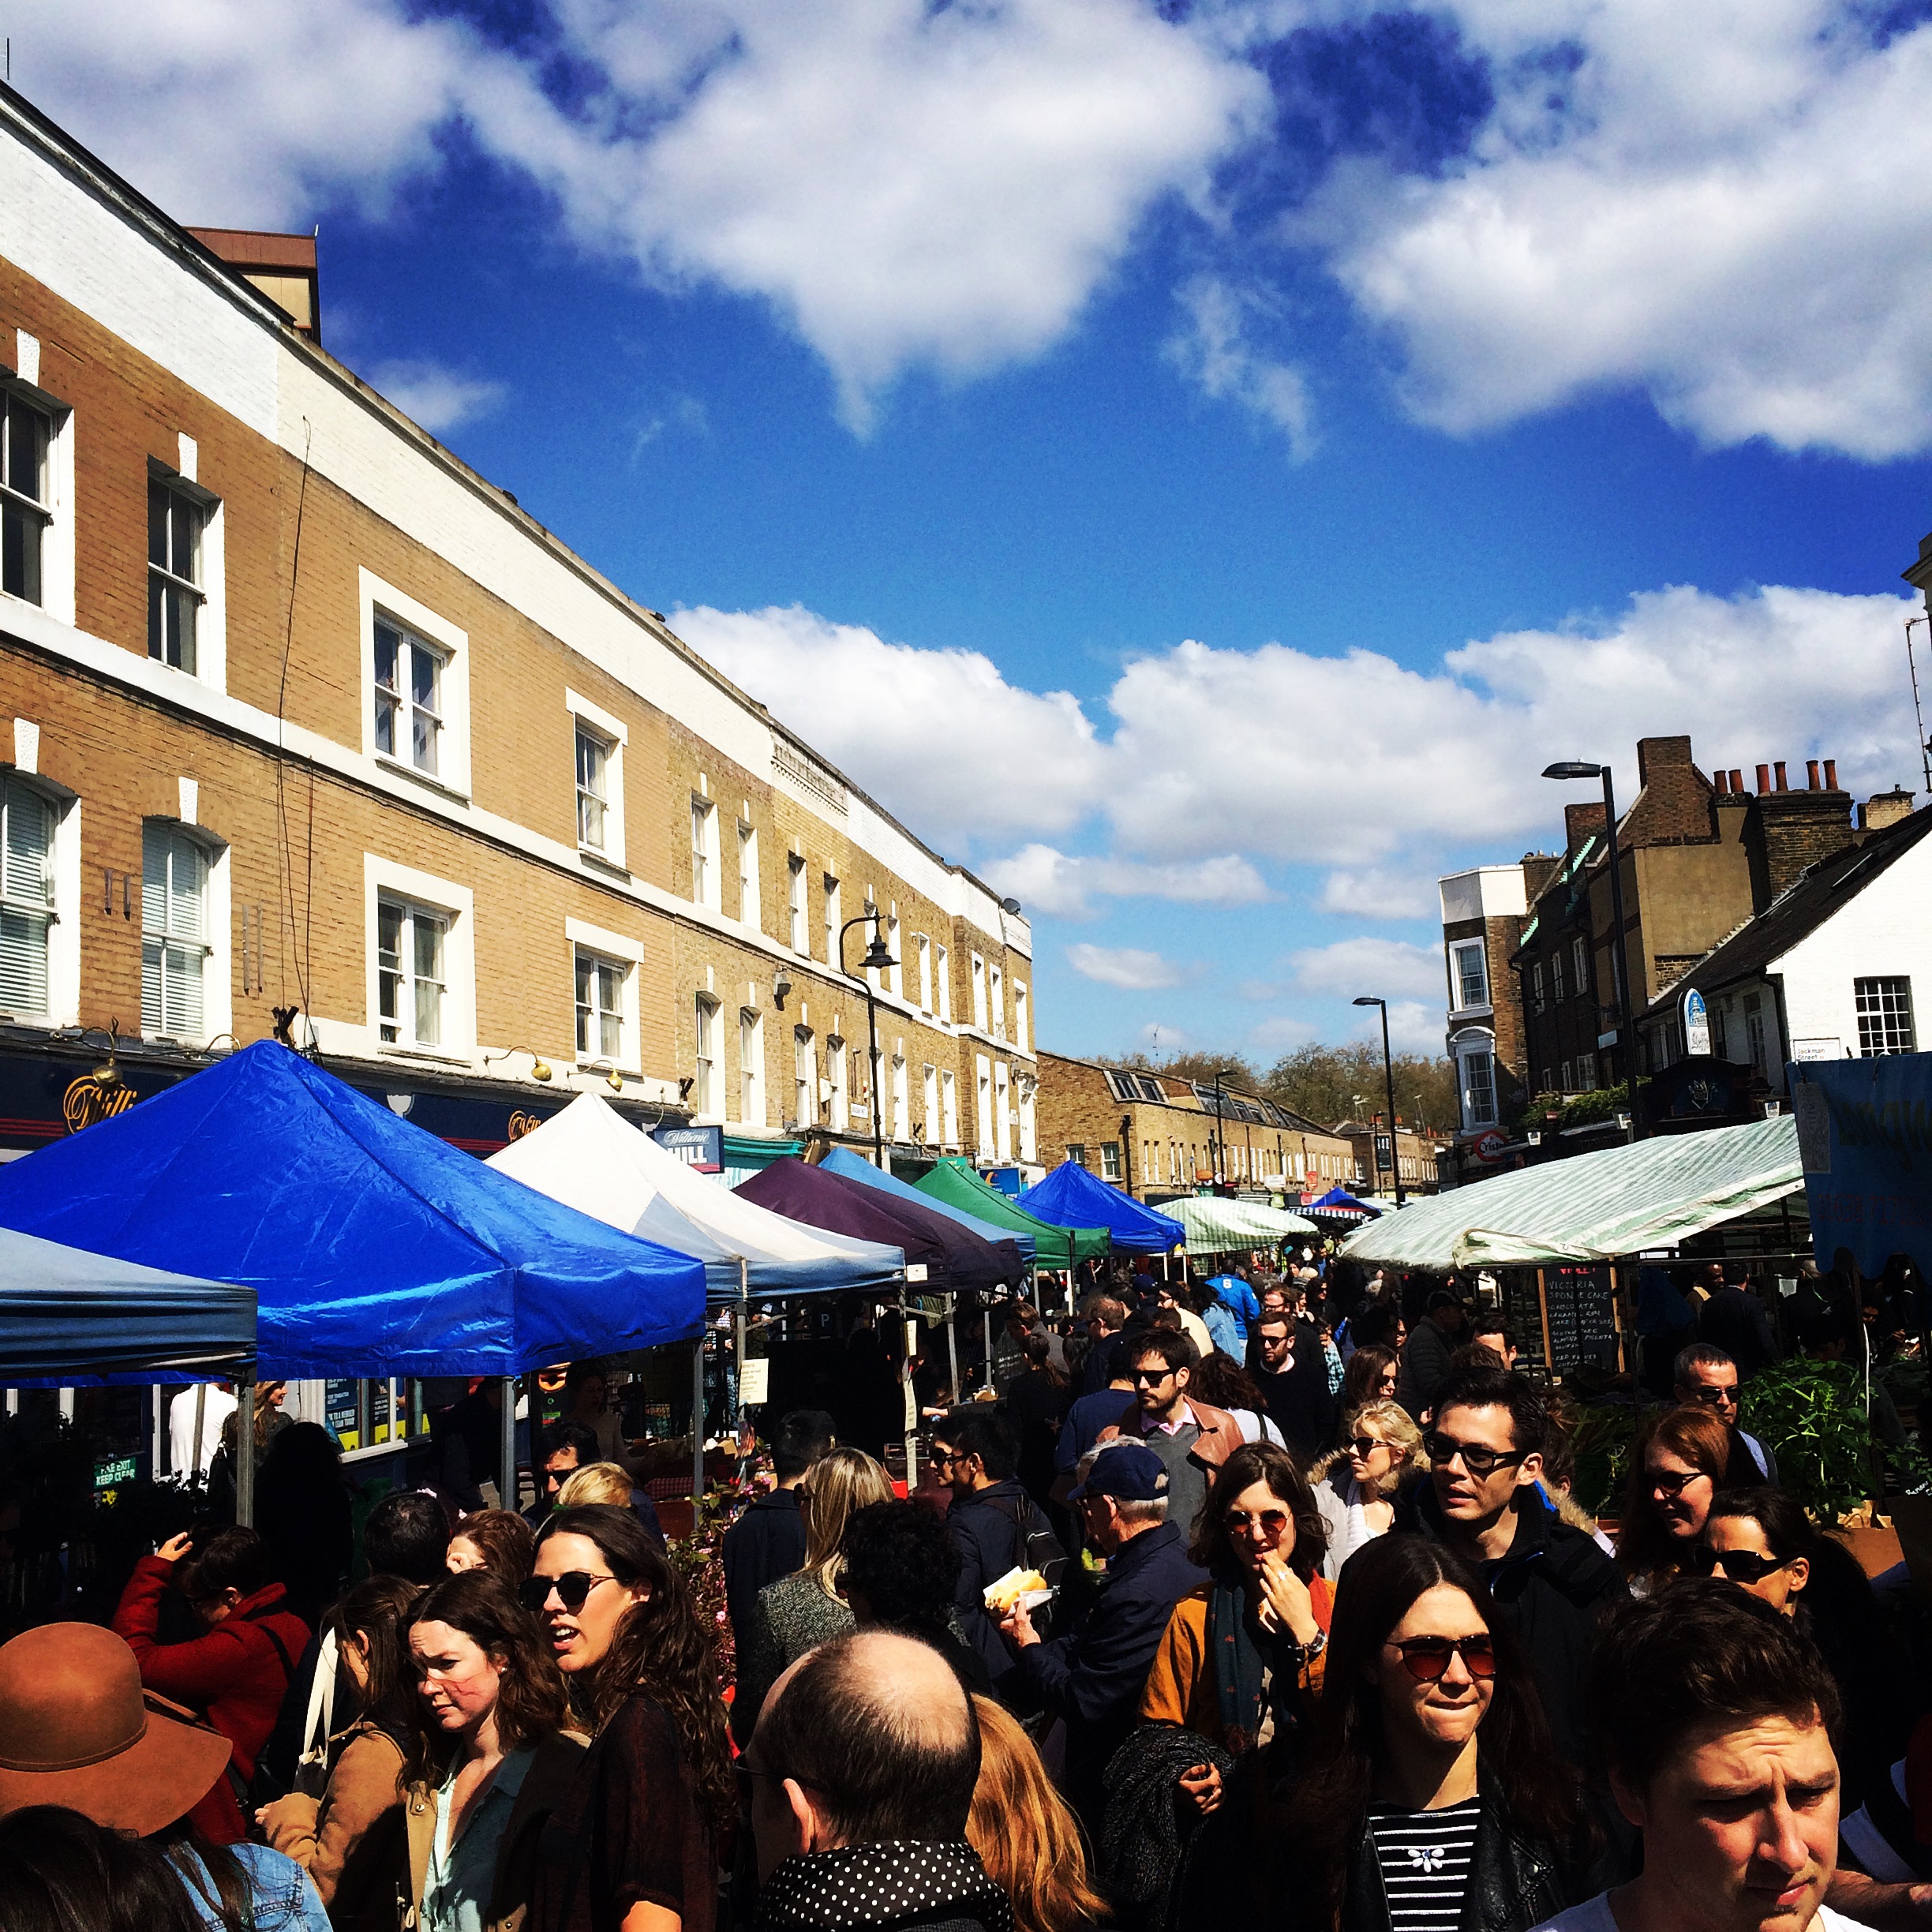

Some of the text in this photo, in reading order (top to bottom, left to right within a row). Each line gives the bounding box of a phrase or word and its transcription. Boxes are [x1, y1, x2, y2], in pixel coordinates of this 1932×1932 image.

[664, 1129, 710, 1147] William
[1548, 1291, 1585, 1300] SPONE
[96, 1473, 113, 1485] KEEP
